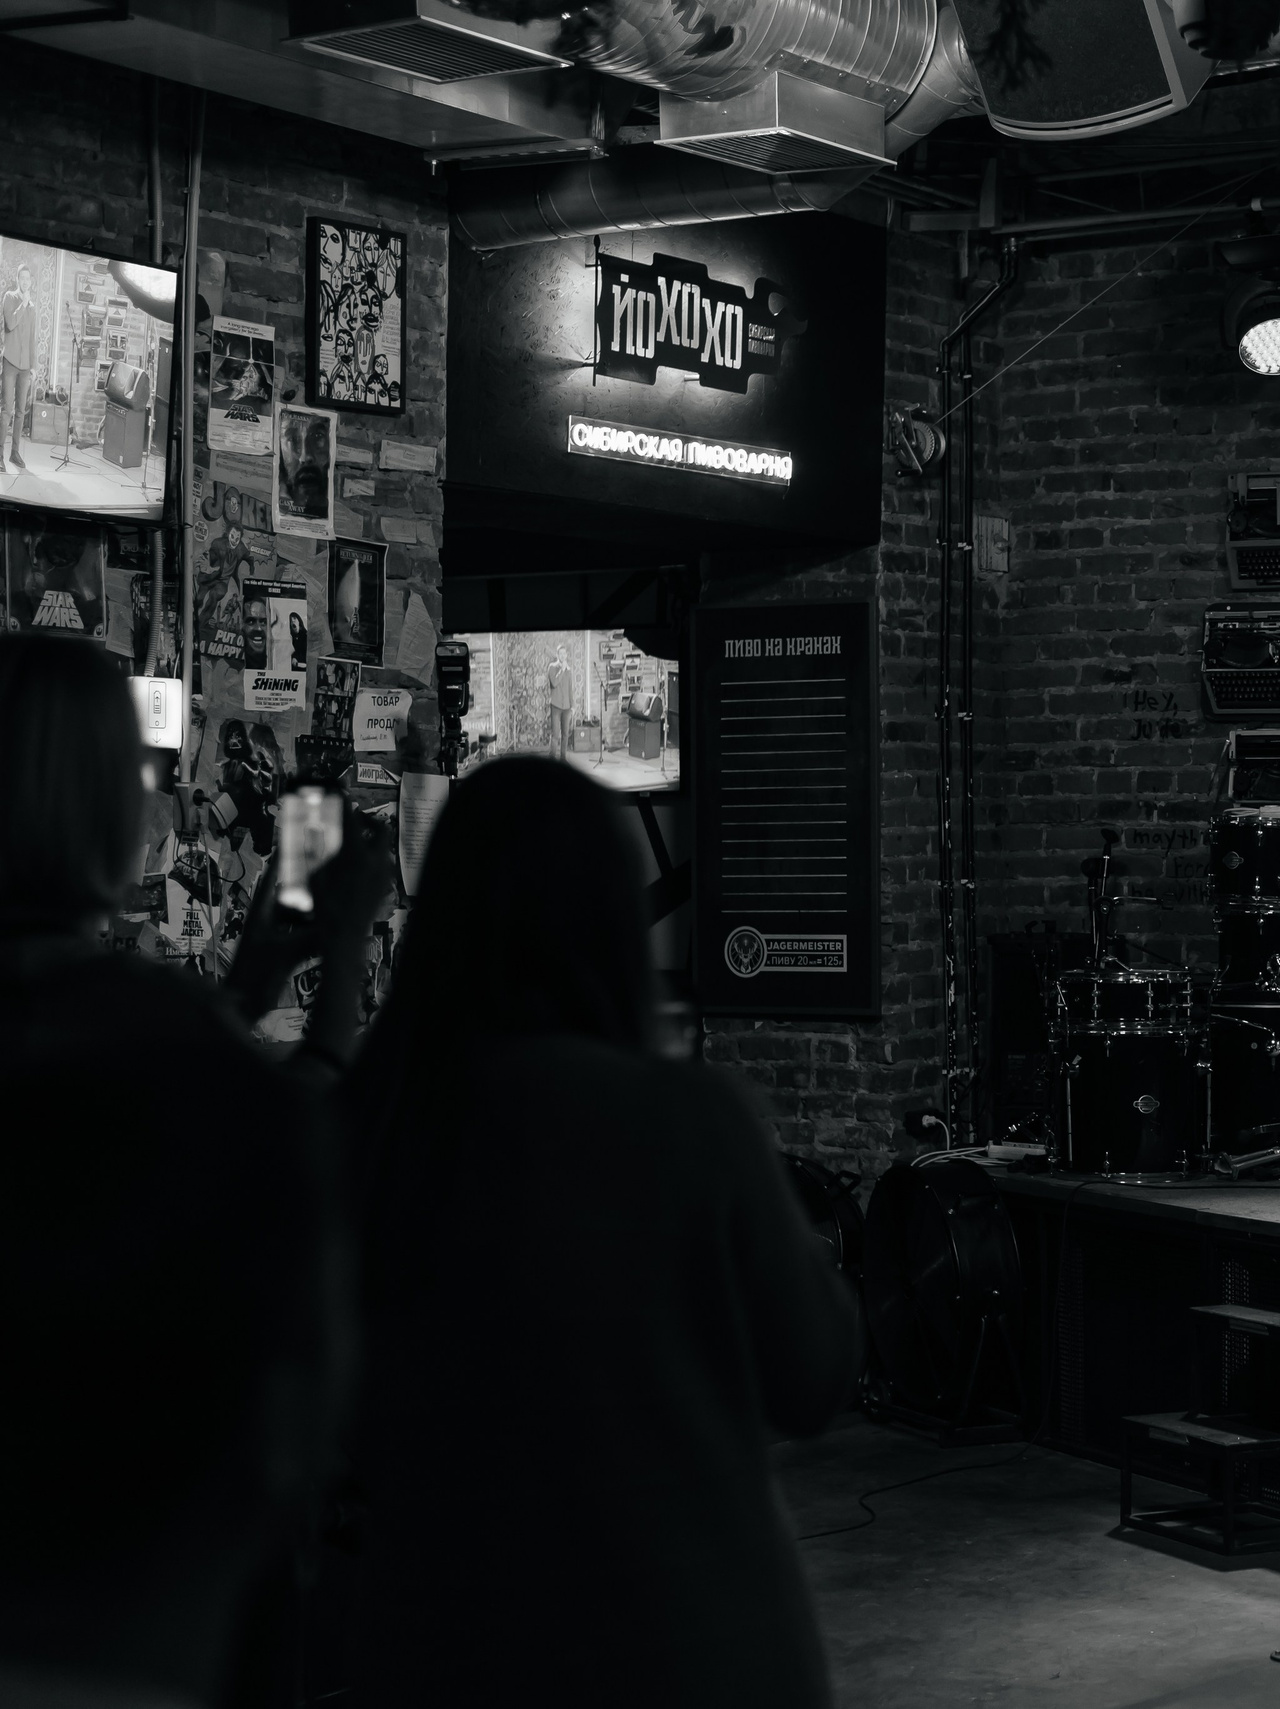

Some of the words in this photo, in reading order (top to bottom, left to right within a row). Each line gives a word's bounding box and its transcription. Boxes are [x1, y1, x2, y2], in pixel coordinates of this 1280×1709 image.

[223, 410, 261, 423] WARS
[570, 423, 683, 463] СИБИРСКАЯ
[685, 441, 793, 480] ПИВОВАРНЯ
[202, 480, 273, 536] JOKE
[43, 590, 77, 608] STAR
[31, 605, 85, 629] WARS
[215, 629, 236, 645] PUT
[236, 633, 245, 648] O
[207, 641, 242, 659] HAPPY
[371, 695, 400, 707] ТОВАР
[1133, 690, 1178, 716] Hey,
[1130, 718, 1183, 741] Jude
[1133, 829, 1177, 858] may
[183, 920, 203, 929] METAL
[186, 911, 200, 920] FULL
[181, 928, 204, 937] JACKET
[767, 941, 843, 951] JAGERMEISTER
[771, 956, 796, 965] ПИВУ
